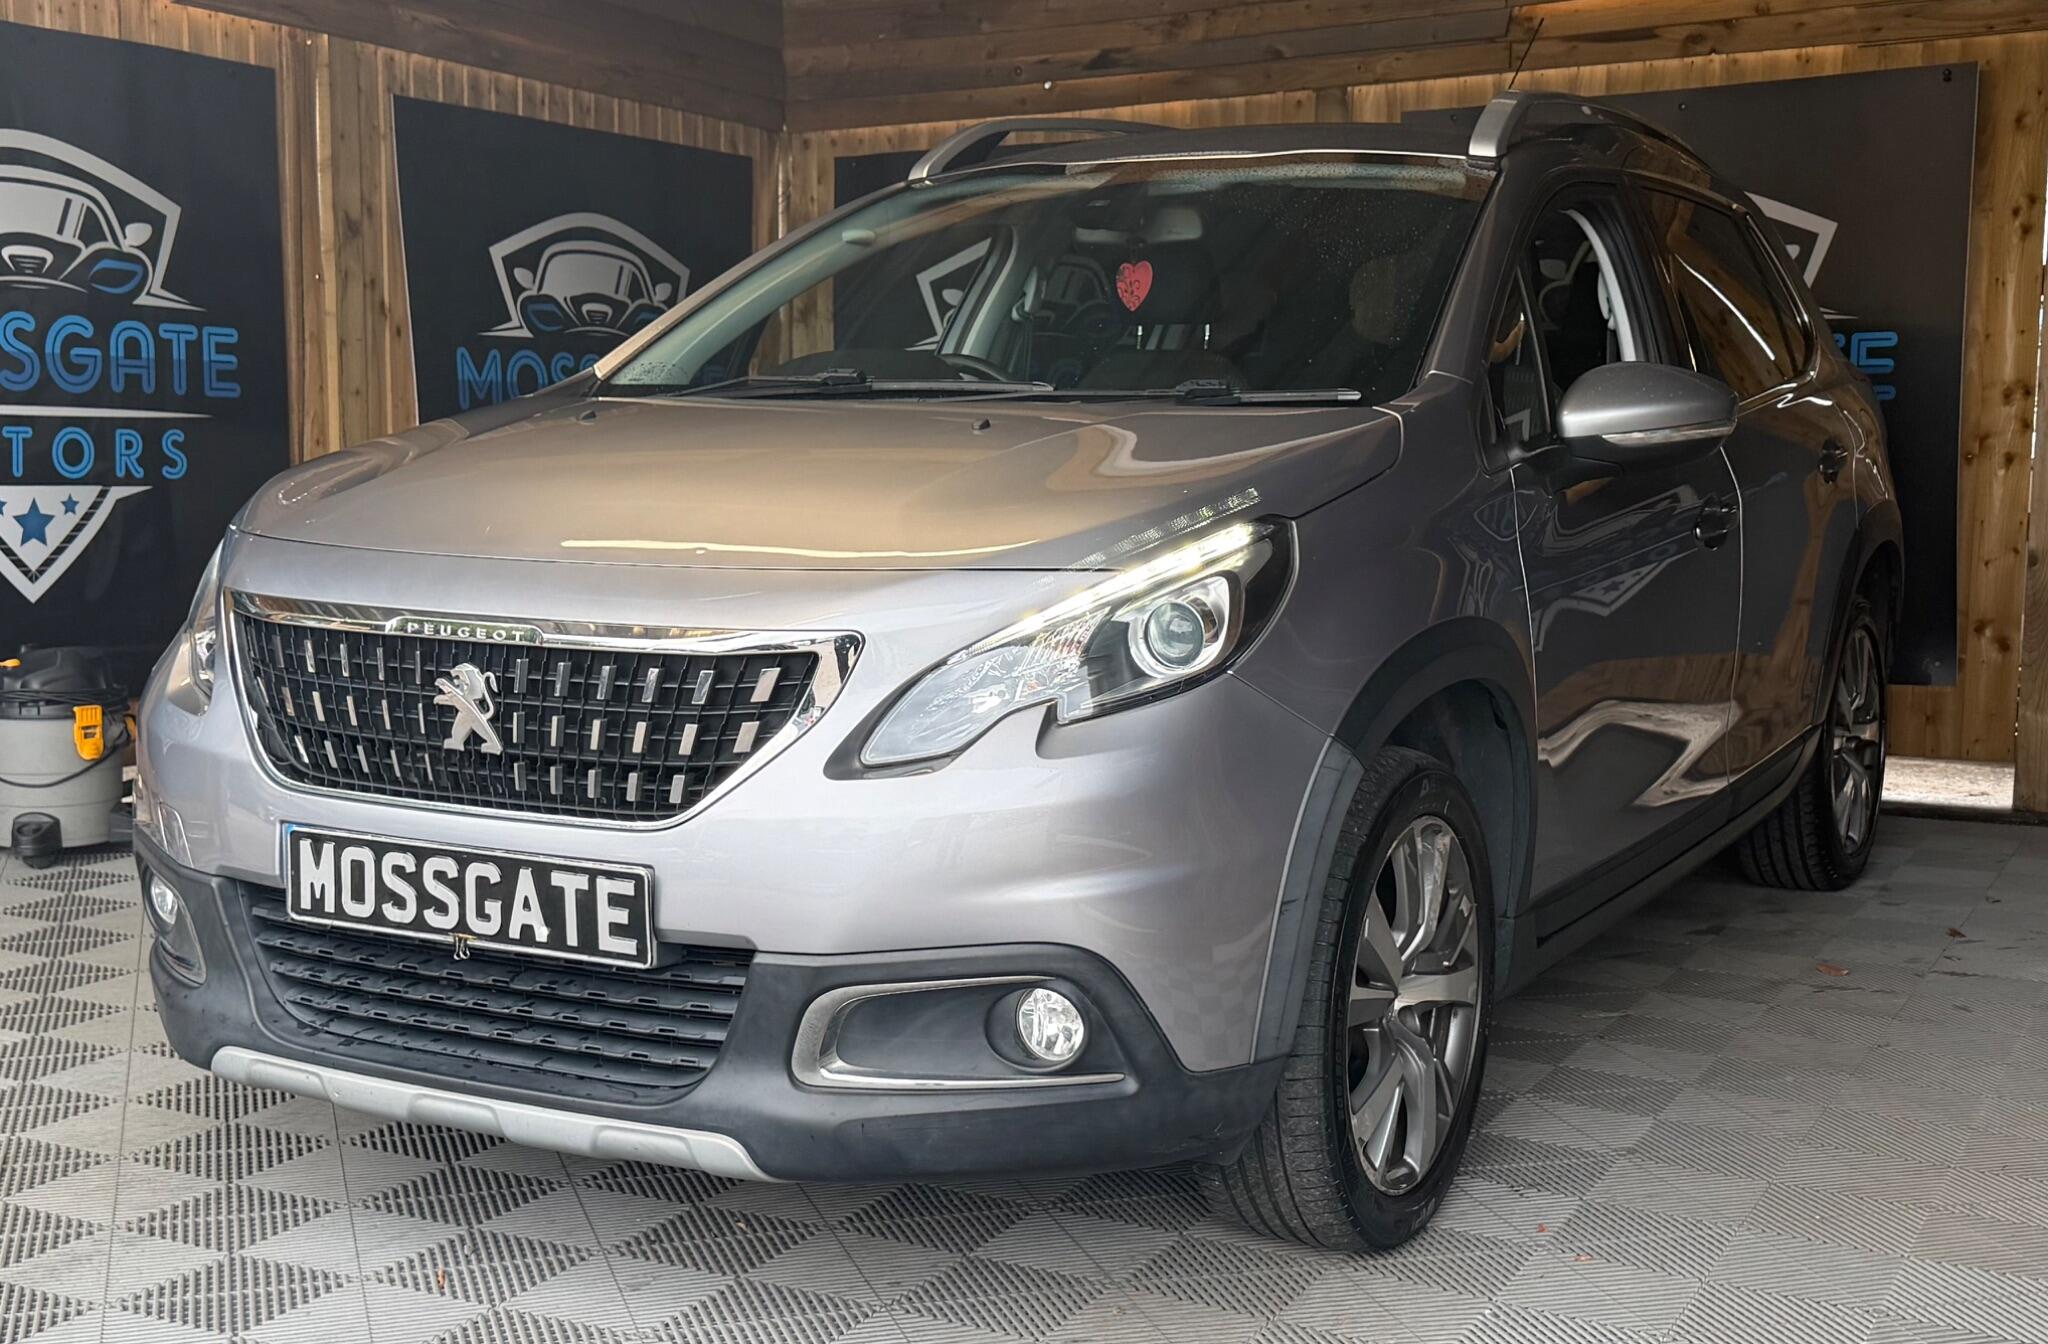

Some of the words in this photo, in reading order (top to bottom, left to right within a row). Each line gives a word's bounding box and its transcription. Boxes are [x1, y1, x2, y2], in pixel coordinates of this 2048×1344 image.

[2, 426, 188, 480] TORS
[407, 621, 525, 642] PEUGEOT
[299, 837, 638, 956] MOSSGATE
